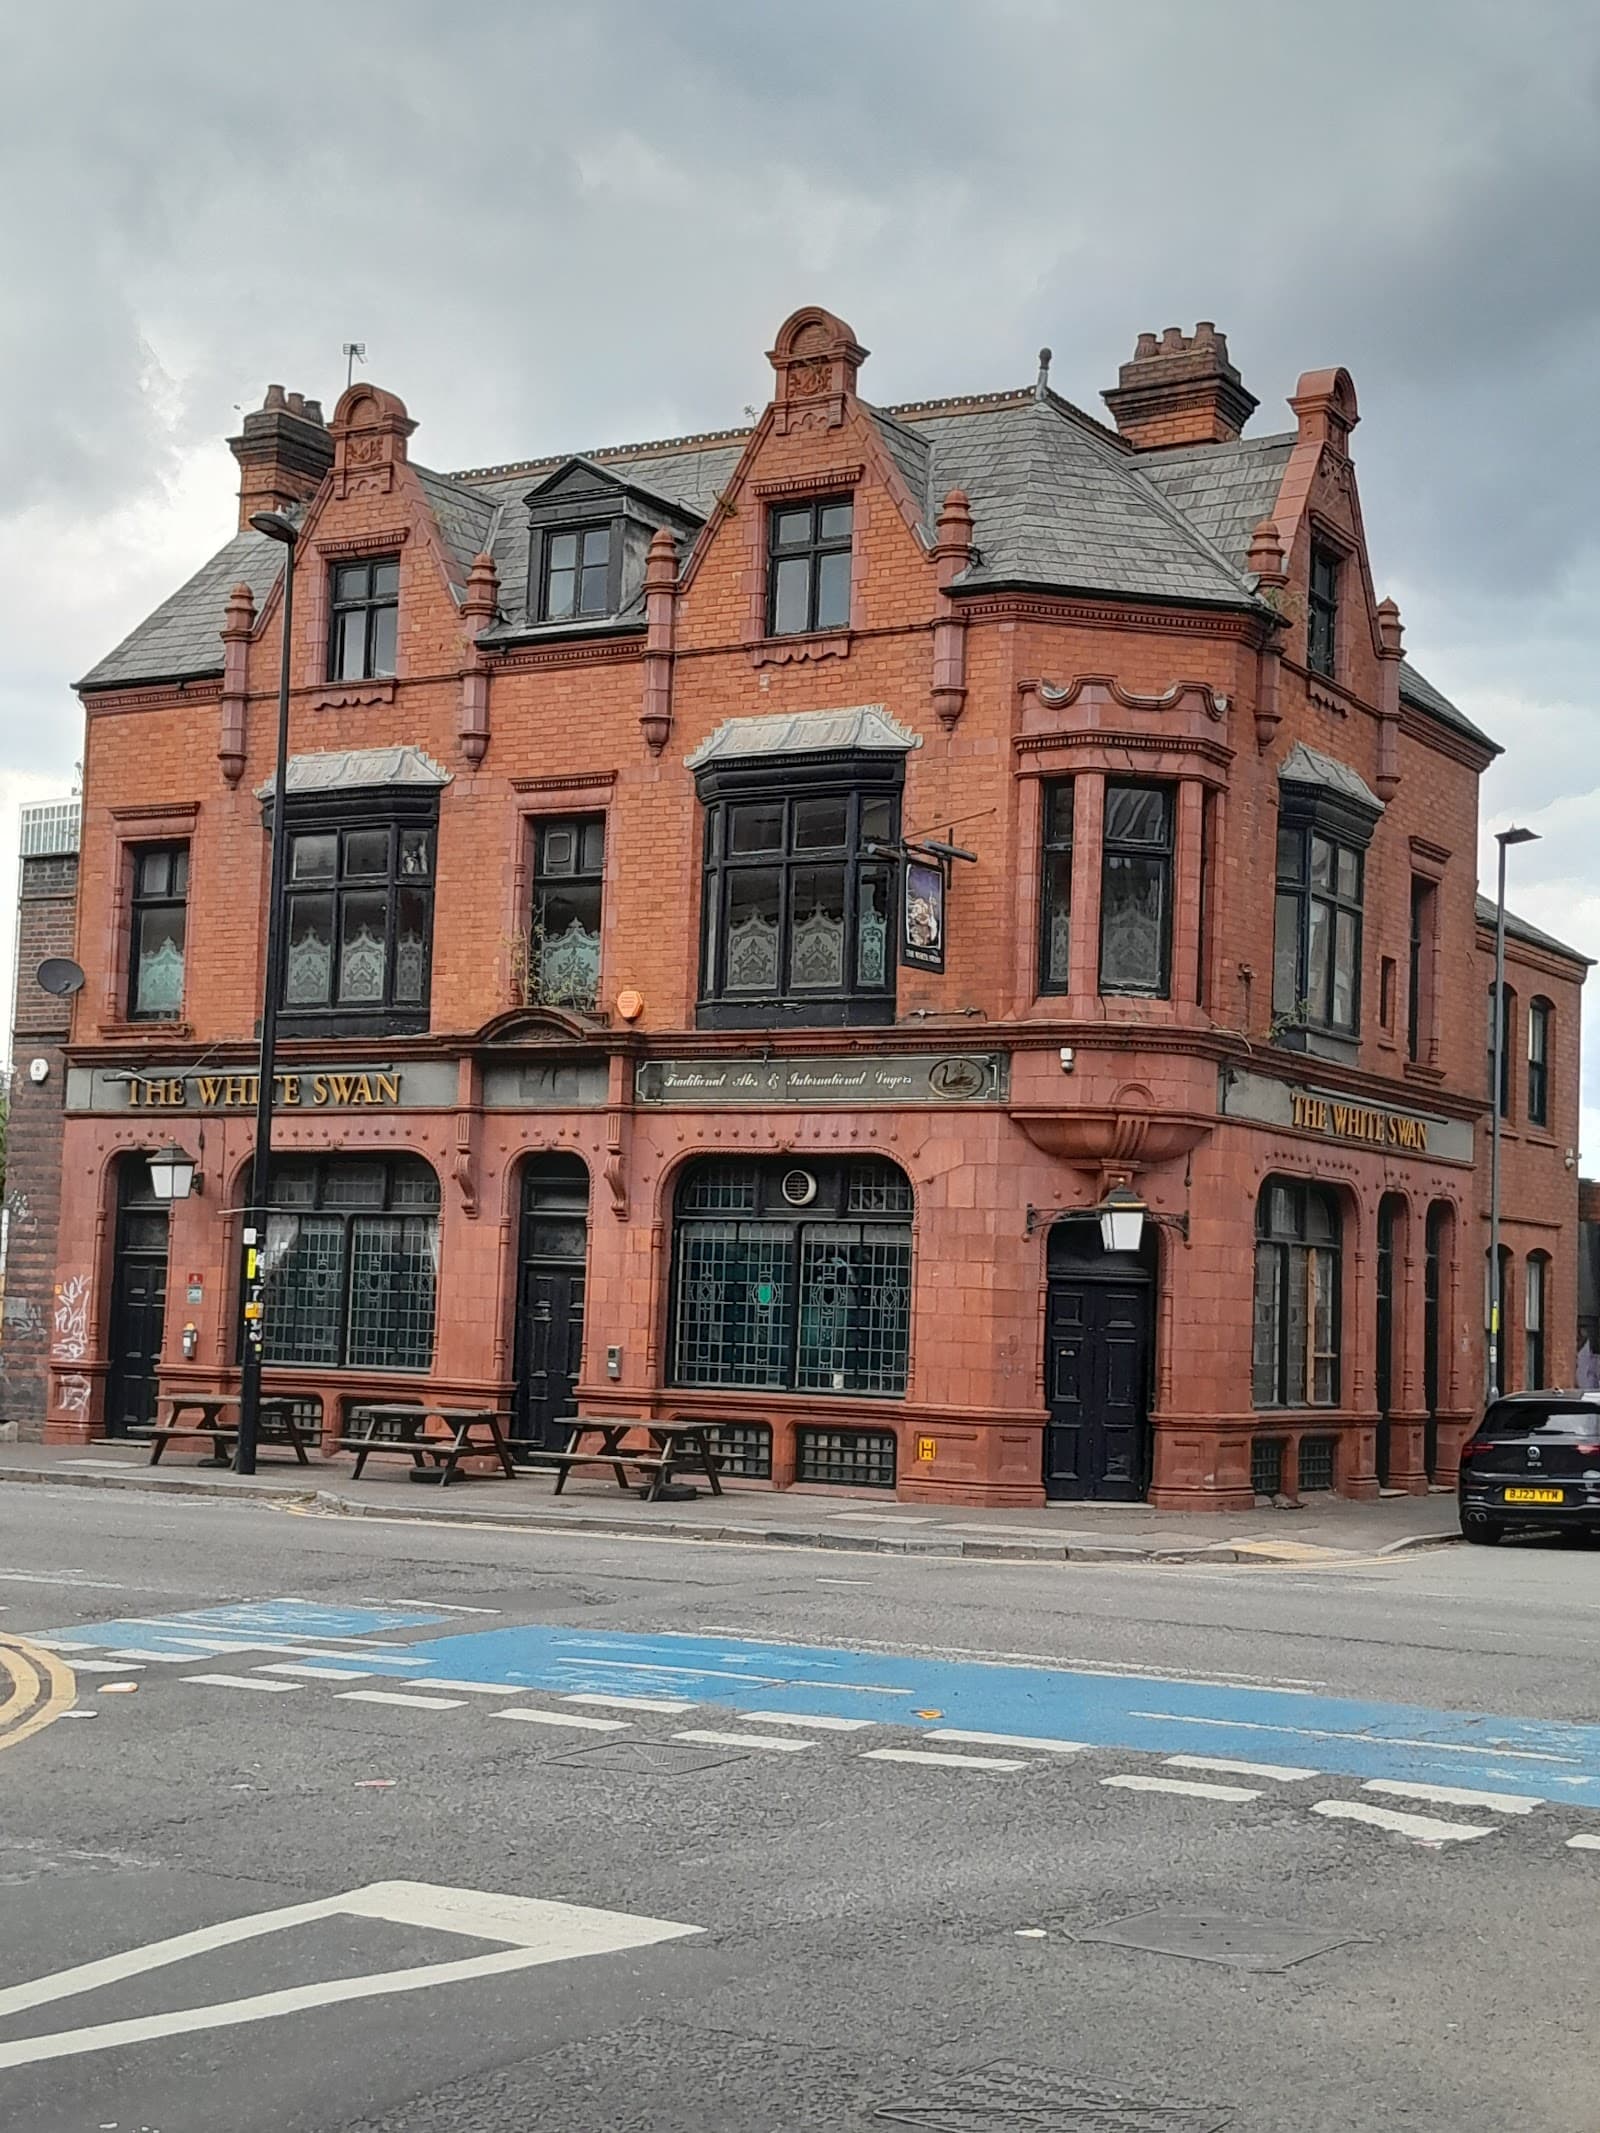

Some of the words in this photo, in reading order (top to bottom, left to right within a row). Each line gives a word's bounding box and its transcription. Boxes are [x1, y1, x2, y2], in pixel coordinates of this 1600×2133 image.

[128, 1077, 185, 1106] THE
[197, 1075, 301, 1106] WHIE
[313, 1072, 401, 1105] SWAN
[664, 1072, 727, 1087] Traditional
[768, 1072, 780, 1090] &
[787, 1071, 867, 1087] International
[1291, 1092, 1328, 1130] THE
[1331, 1103, 1385, 1141] WHITE
[1388, 1115, 1428, 1151] SWAN
[921, 1440, 934, 1458] H
